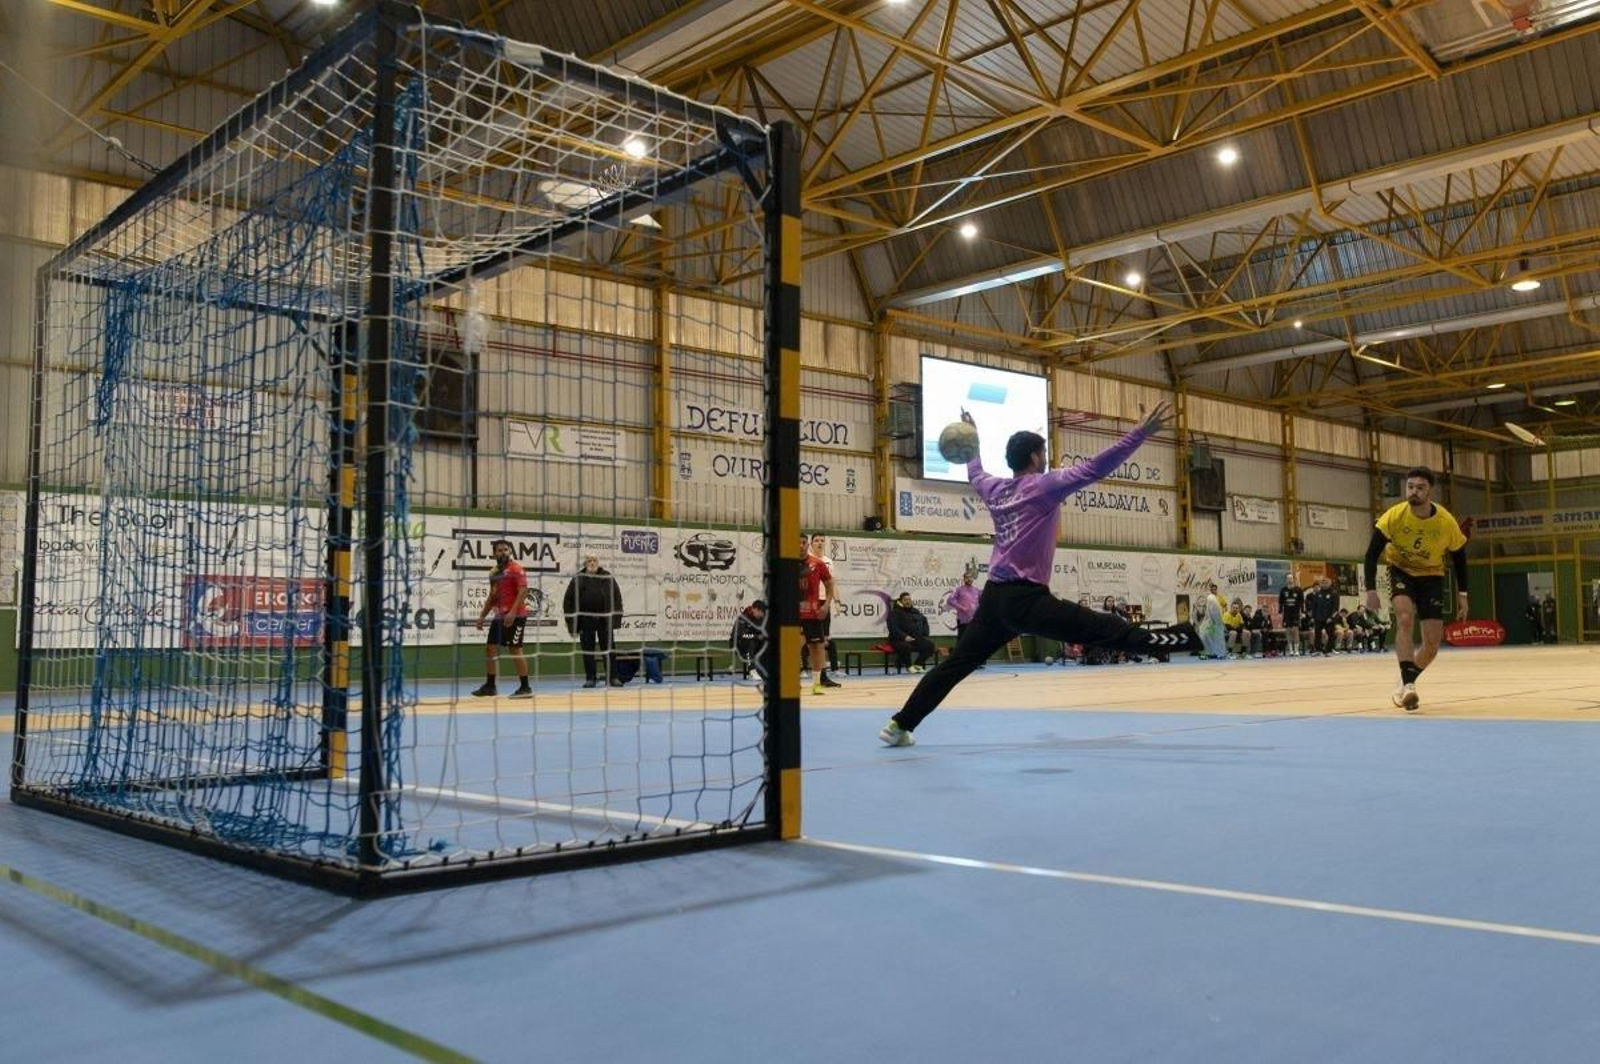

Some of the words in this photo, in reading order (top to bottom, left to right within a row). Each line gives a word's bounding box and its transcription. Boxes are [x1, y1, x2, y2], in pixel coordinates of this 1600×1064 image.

[712, 454, 830, 486] OURSE
[915, 495, 942, 506] XUNTA
[1074, 490, 1150, 513] RIBADAVIA
[915, 505, 926, 516] DE
[928, 506, 959, 518] GALICIA
[1414, 537, 1422, 550] 6
[457, 540, 556, 562] ALAMA
[839, 603, 880, 617] RUBI
